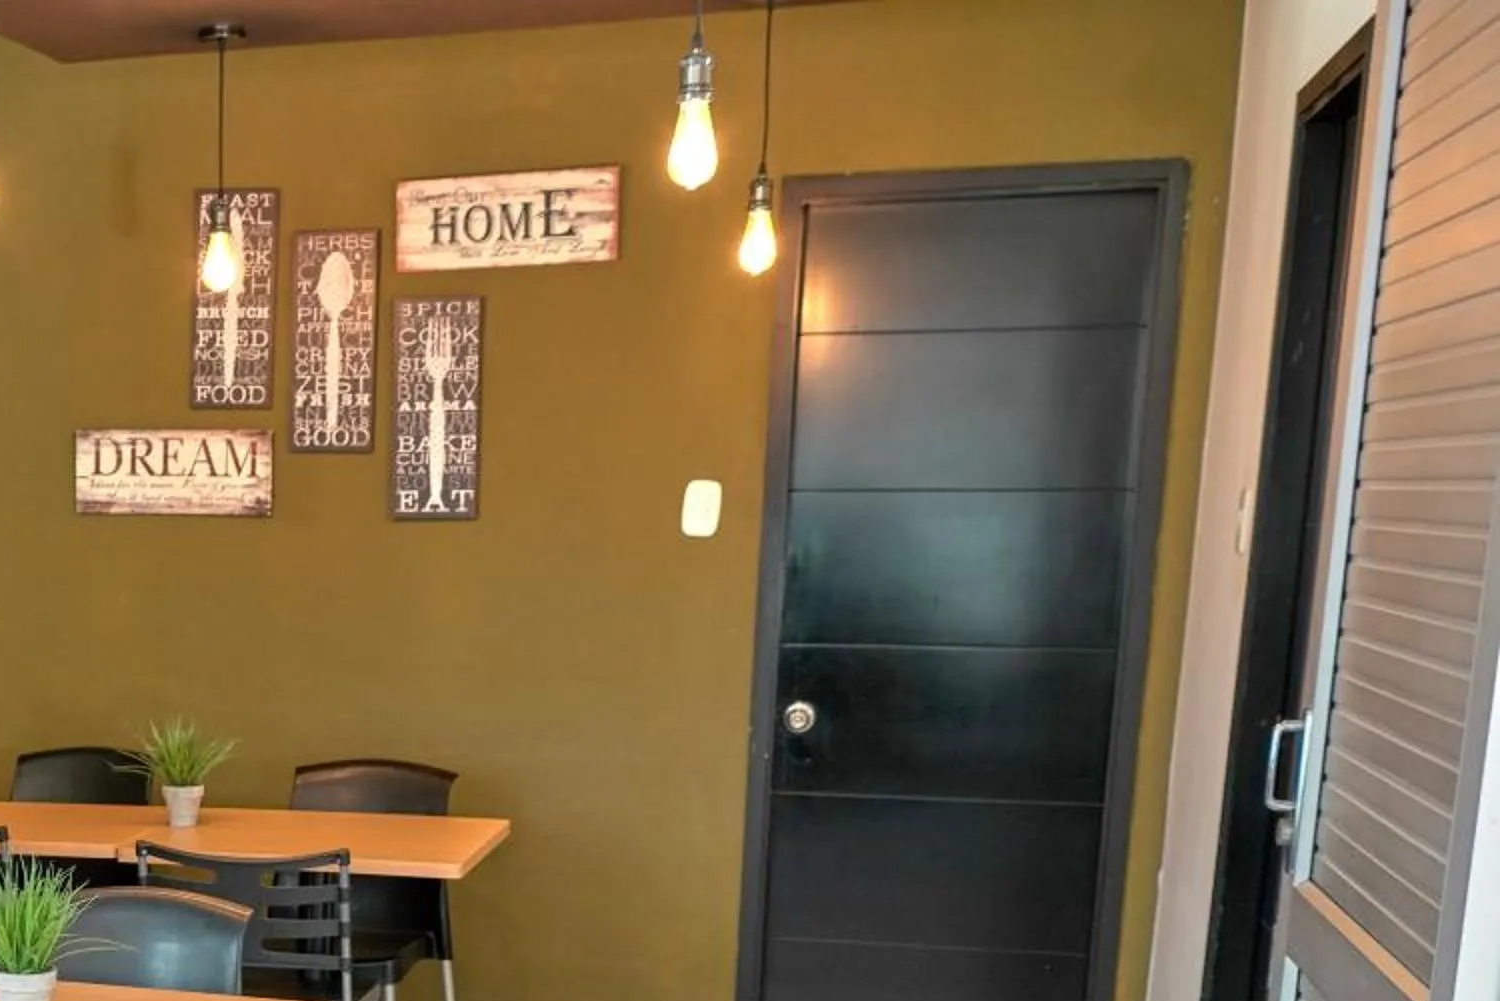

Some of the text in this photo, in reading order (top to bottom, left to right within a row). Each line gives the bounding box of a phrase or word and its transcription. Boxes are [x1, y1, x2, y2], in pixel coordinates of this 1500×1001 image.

[200, 207, 273, 225] MAL
[430, 189, 581, 246] HOME
[297, 233, 374, 251] HERBS
[400, 301, 480, 317] SPICE
[195, 385, 266, 404] FOOD
[397, 383, 478, 401] BRW
[397, 401, 478, 412] ARMA
[293, 428, 371, 447] GOOD
[91, 437, 263, 478] DREAM
[395, 489, 476, 513] EAT
